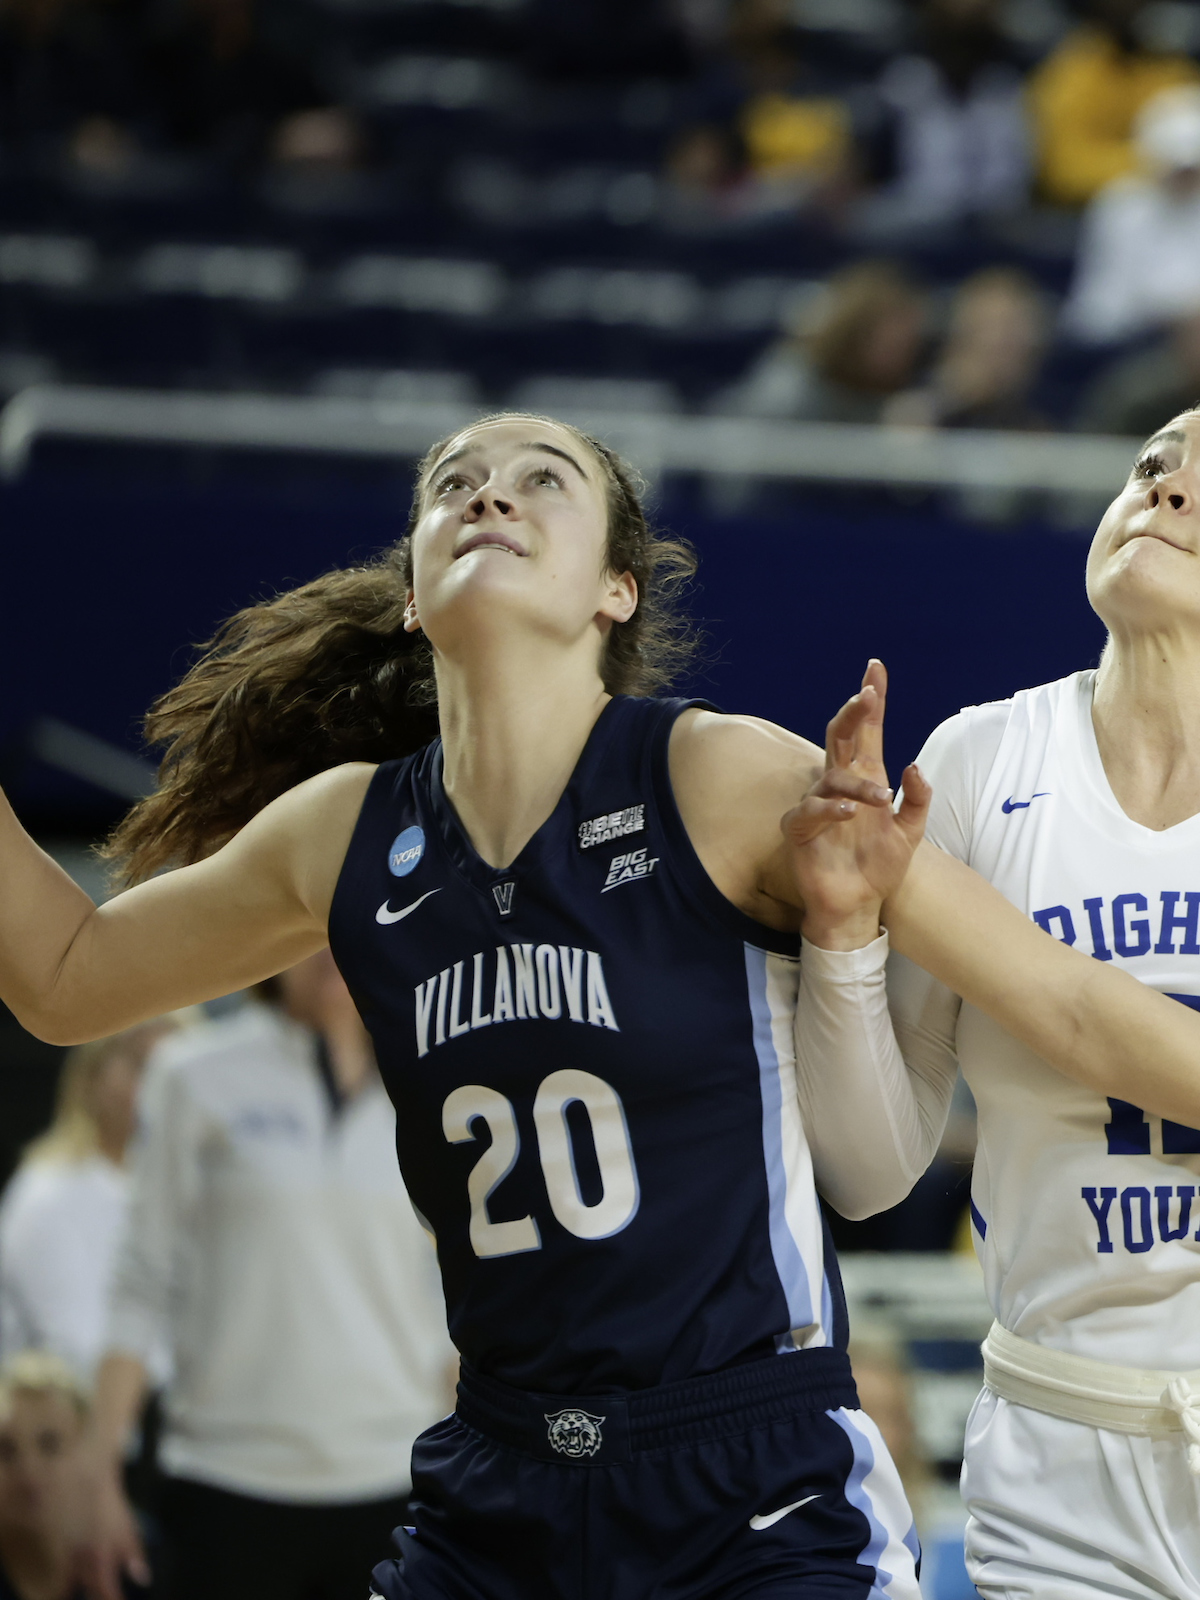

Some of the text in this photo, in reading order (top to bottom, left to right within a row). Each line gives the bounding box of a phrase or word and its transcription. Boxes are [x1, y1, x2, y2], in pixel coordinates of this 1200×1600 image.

[580, 819, 645, 849] CHANGE
[392, 844, 422, 867] NCAA
[609, 847, 648, 872] BIG
[604, 858, 660, 886] EAST
[414, 943, 621, 1058] VILLANOVA
[442, 1068, 641, 1258] 20
